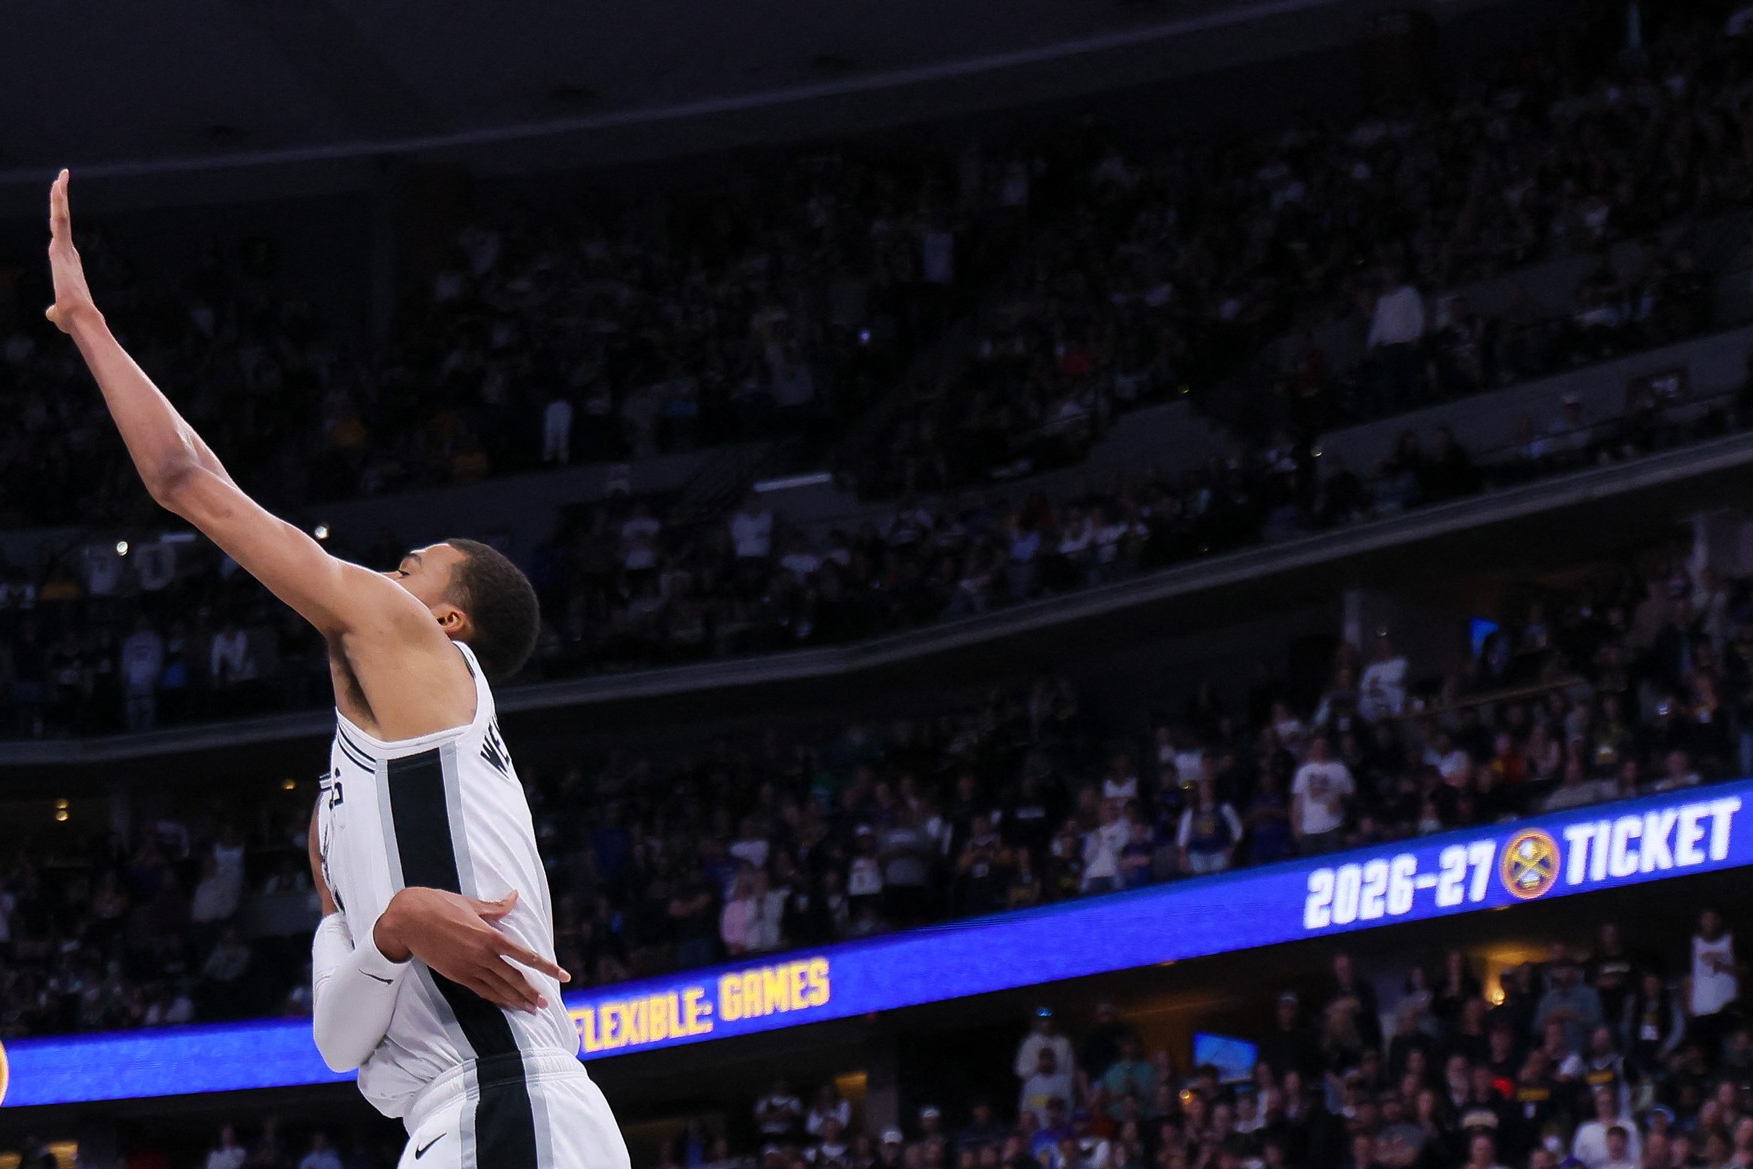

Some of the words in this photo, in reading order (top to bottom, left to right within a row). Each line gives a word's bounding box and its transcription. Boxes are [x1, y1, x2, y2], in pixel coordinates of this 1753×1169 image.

[1303, 838, 1496, 929] 2026-27
[1563, 796, 1742, 886] TICKET
[718, 957, 831, 1022] GAMES
